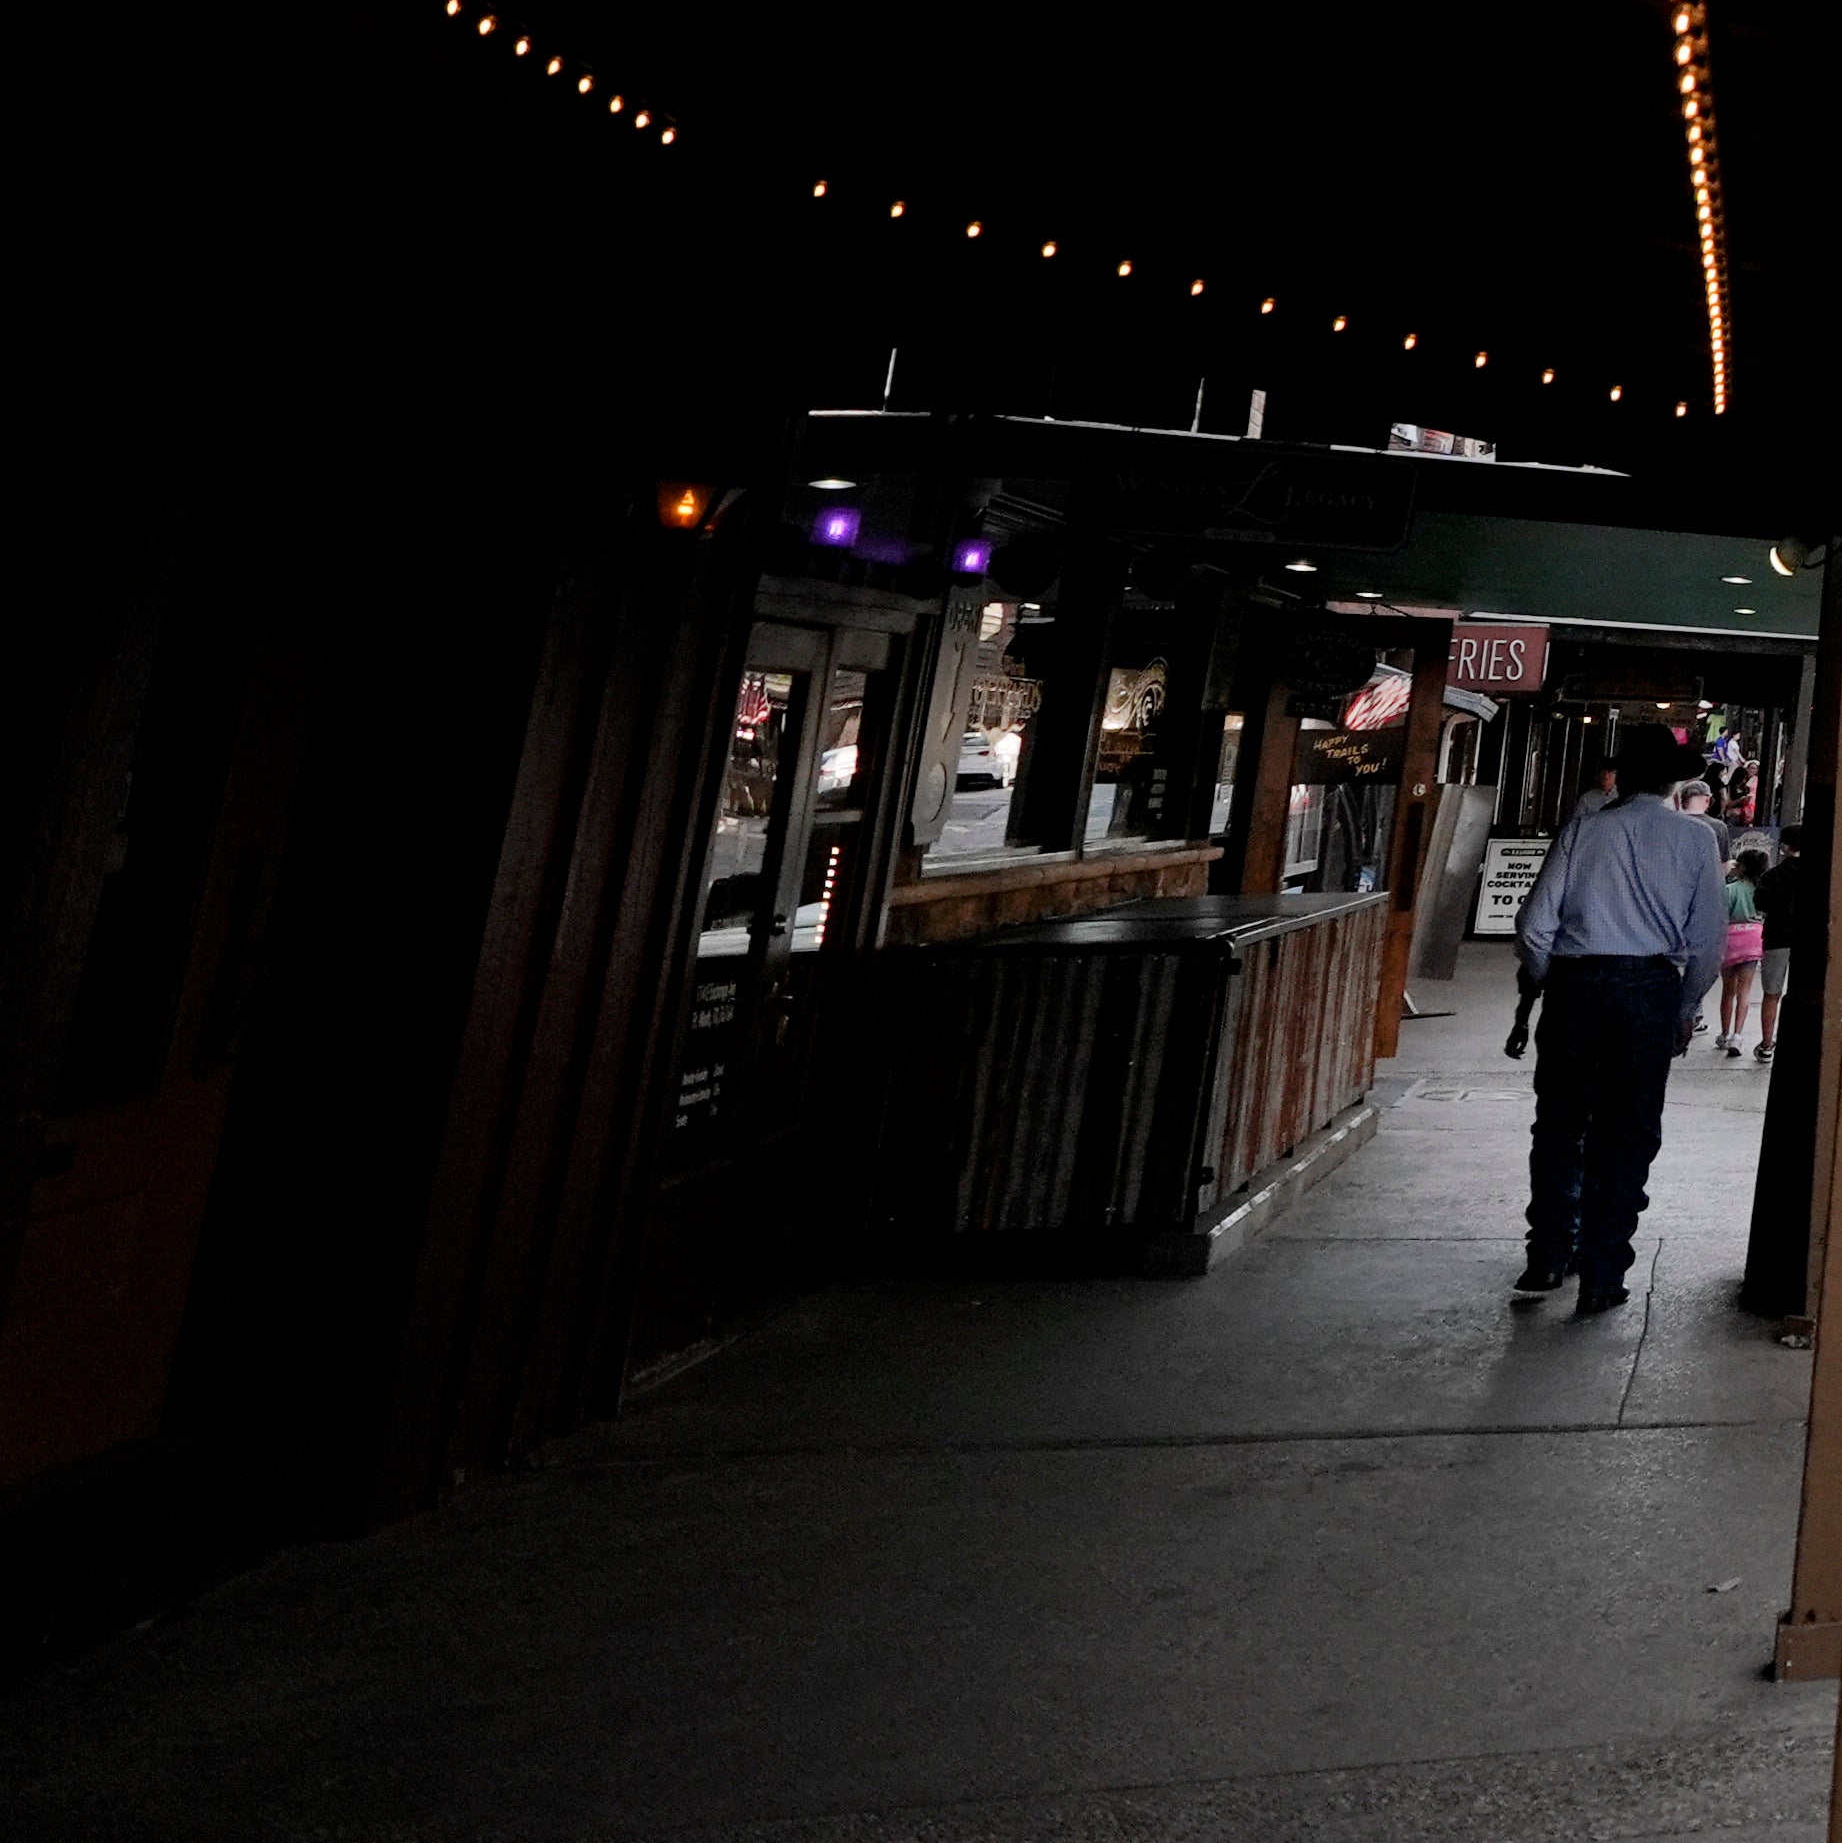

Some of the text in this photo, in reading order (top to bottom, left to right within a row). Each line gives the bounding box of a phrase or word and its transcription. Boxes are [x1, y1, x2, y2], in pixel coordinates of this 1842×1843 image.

[1313, 734, 1350, 750] HAPPY
[1326, 743, 1369, 759] TRAILS
[1347, 756, 1362, 766] TO
[1507, 862, 1532, 870] NOW
[1491, 894, 1513, 906] TO
